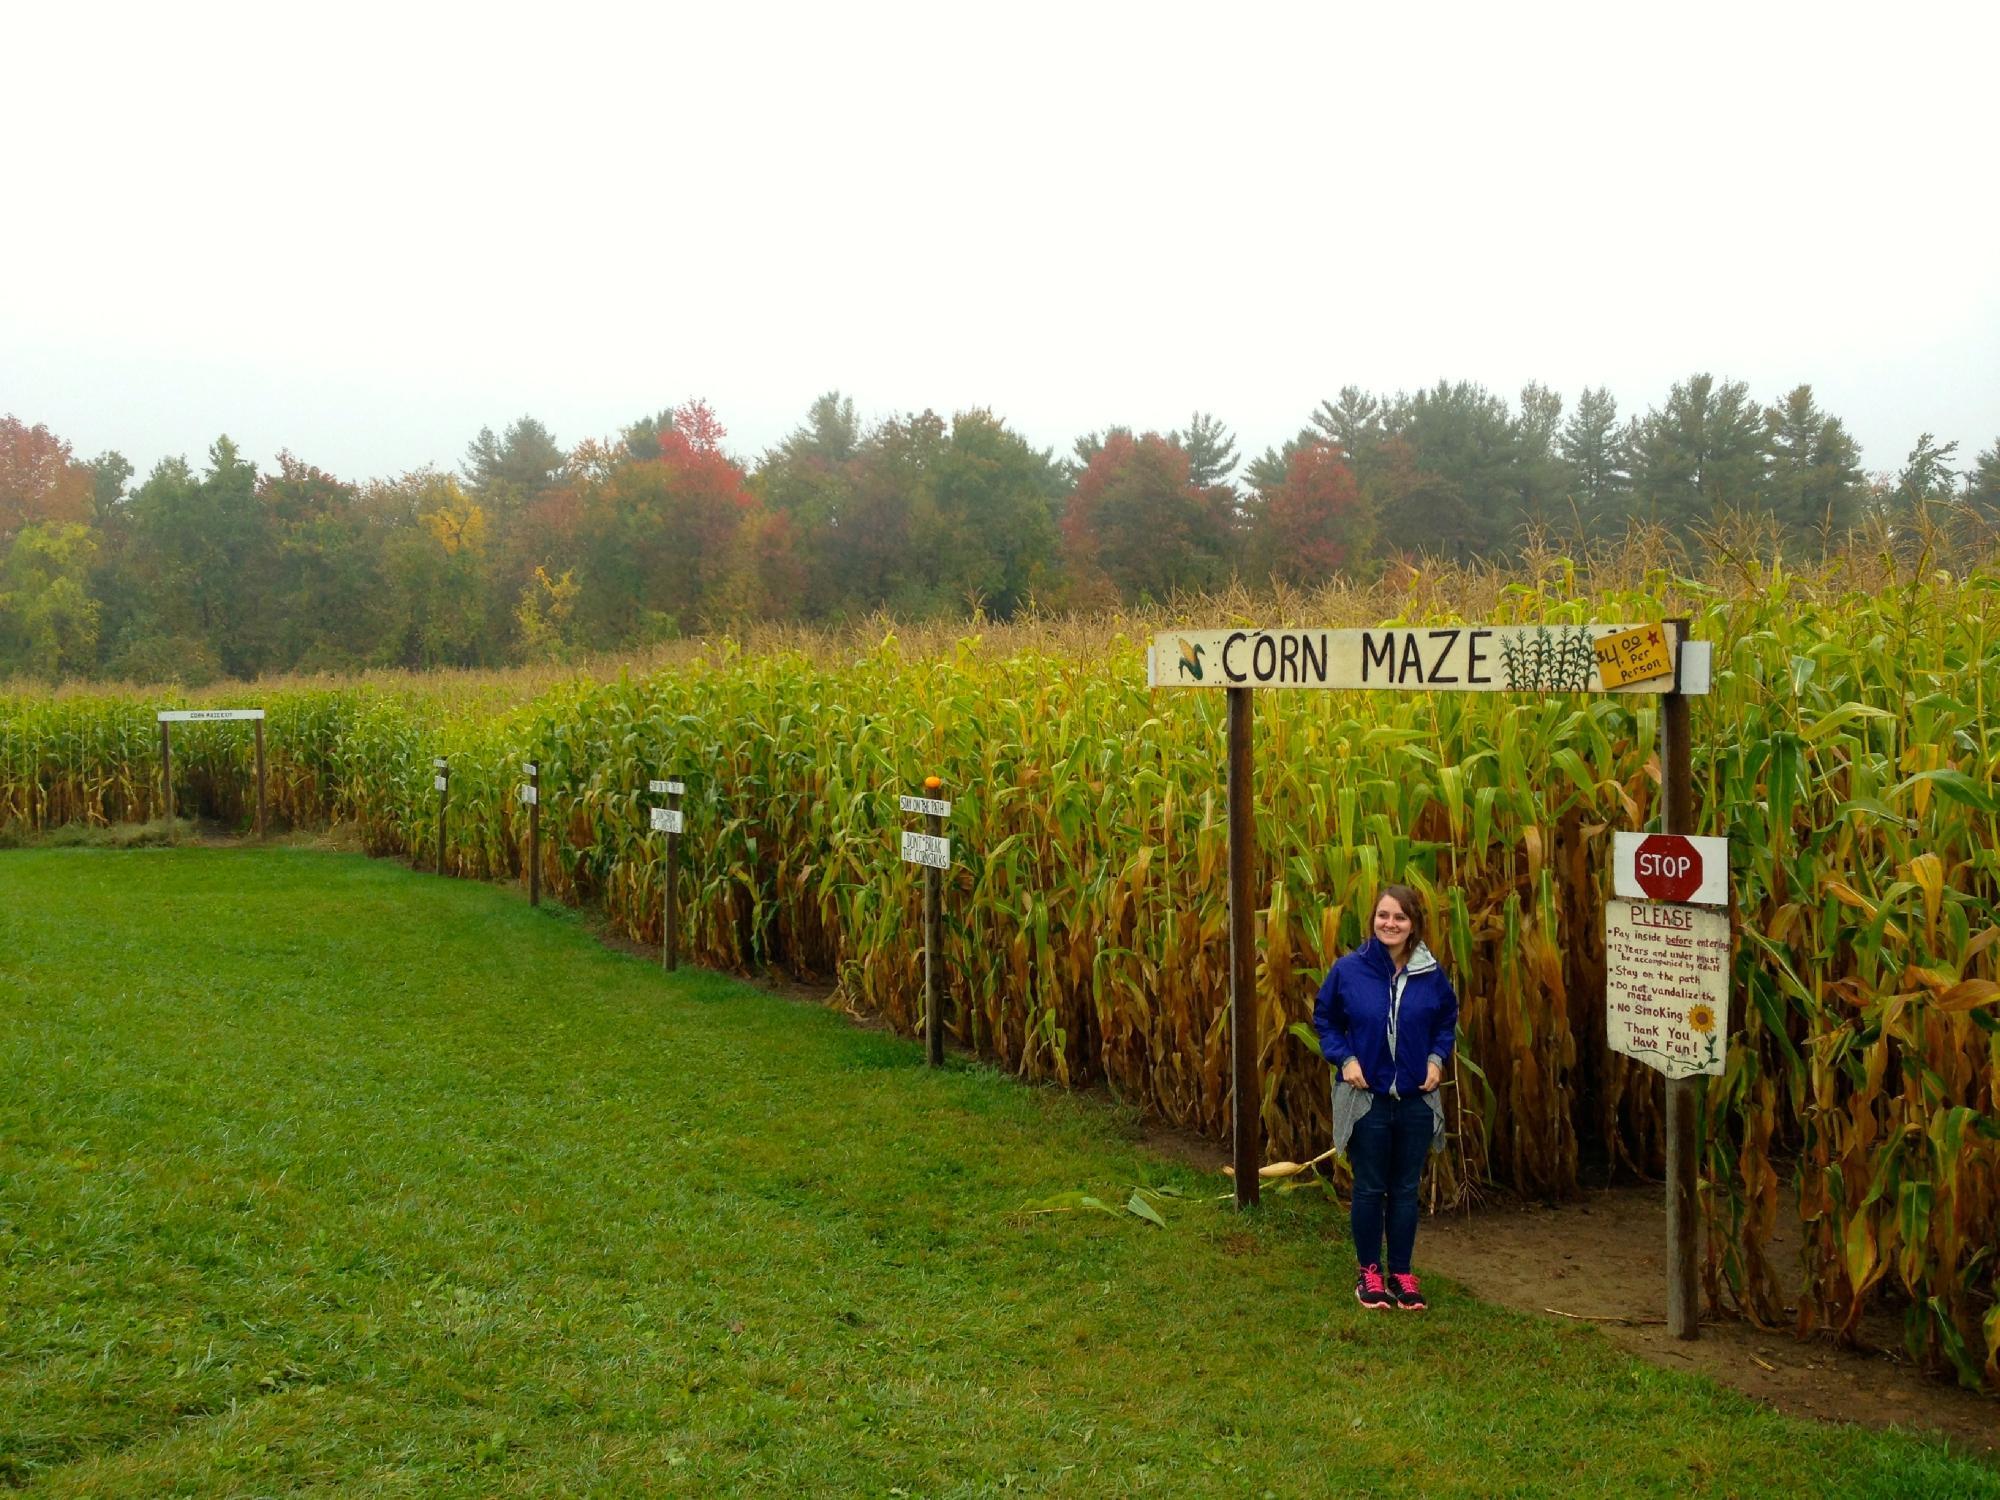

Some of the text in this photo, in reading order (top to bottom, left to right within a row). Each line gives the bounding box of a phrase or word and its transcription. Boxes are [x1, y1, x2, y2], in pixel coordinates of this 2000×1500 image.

[1222, 631, 1492, 683] CORN MAZE
[1640, 853, 1690, 878] STOP
[1631, 906, 1693, 929] PLEASE
[1613, 927, 1730, 953] Pay inside before entering
[1614, 944, 1622, 953] 12
[1653, 950, 1667, 958] and
[1670, 951, 1693, 961] under
[1635, 957, 1682, 968] accompanied
[1686, 962, 1694, 971] by
[1697, 963, 1720, 972] adult
[1616, 965, 1701, 986] Stay on the path
[1616, 981, 1716, 1002] Do not vandalize the
[1627, 991, 1653, 1002] maze
[1633, 1036, 1658, 1049] Have
[1668, 1027, 1690, 1041] You
